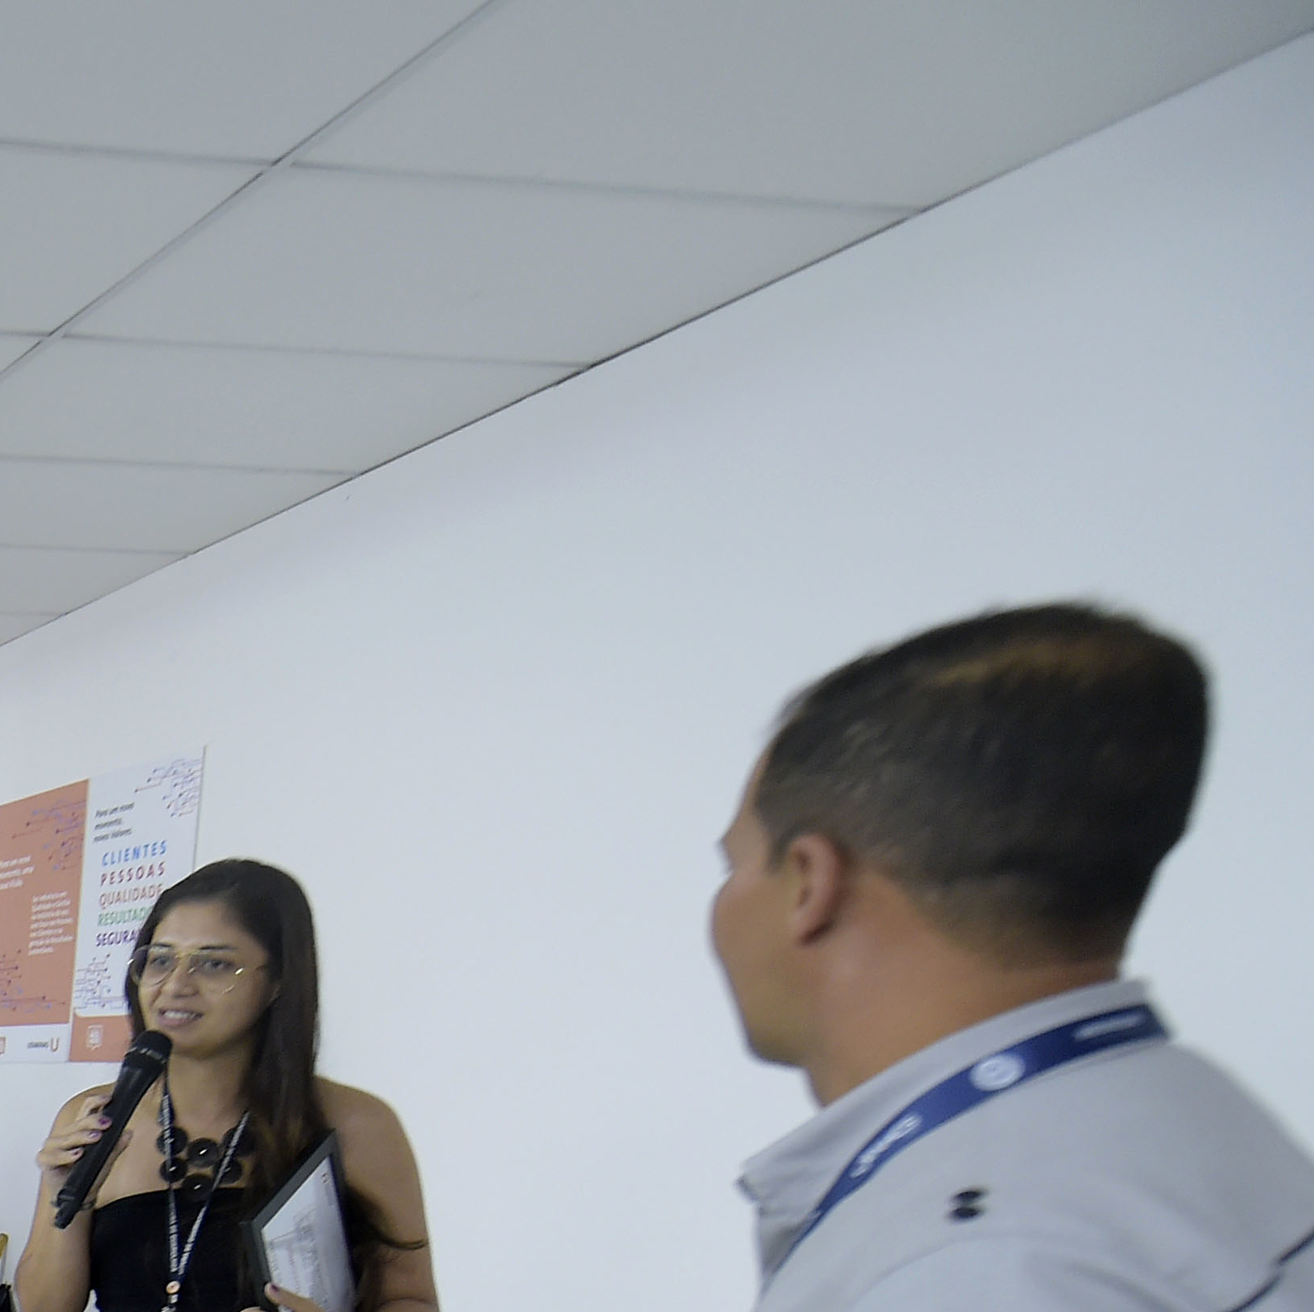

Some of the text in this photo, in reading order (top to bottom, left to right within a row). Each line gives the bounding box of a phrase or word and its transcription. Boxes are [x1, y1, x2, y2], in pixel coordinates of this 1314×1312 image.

[102, 840, 166, 867] CLIENTES
[100, 861, 165, 887] PESSOAS
[96, 929, 140, 947] SEGURA
